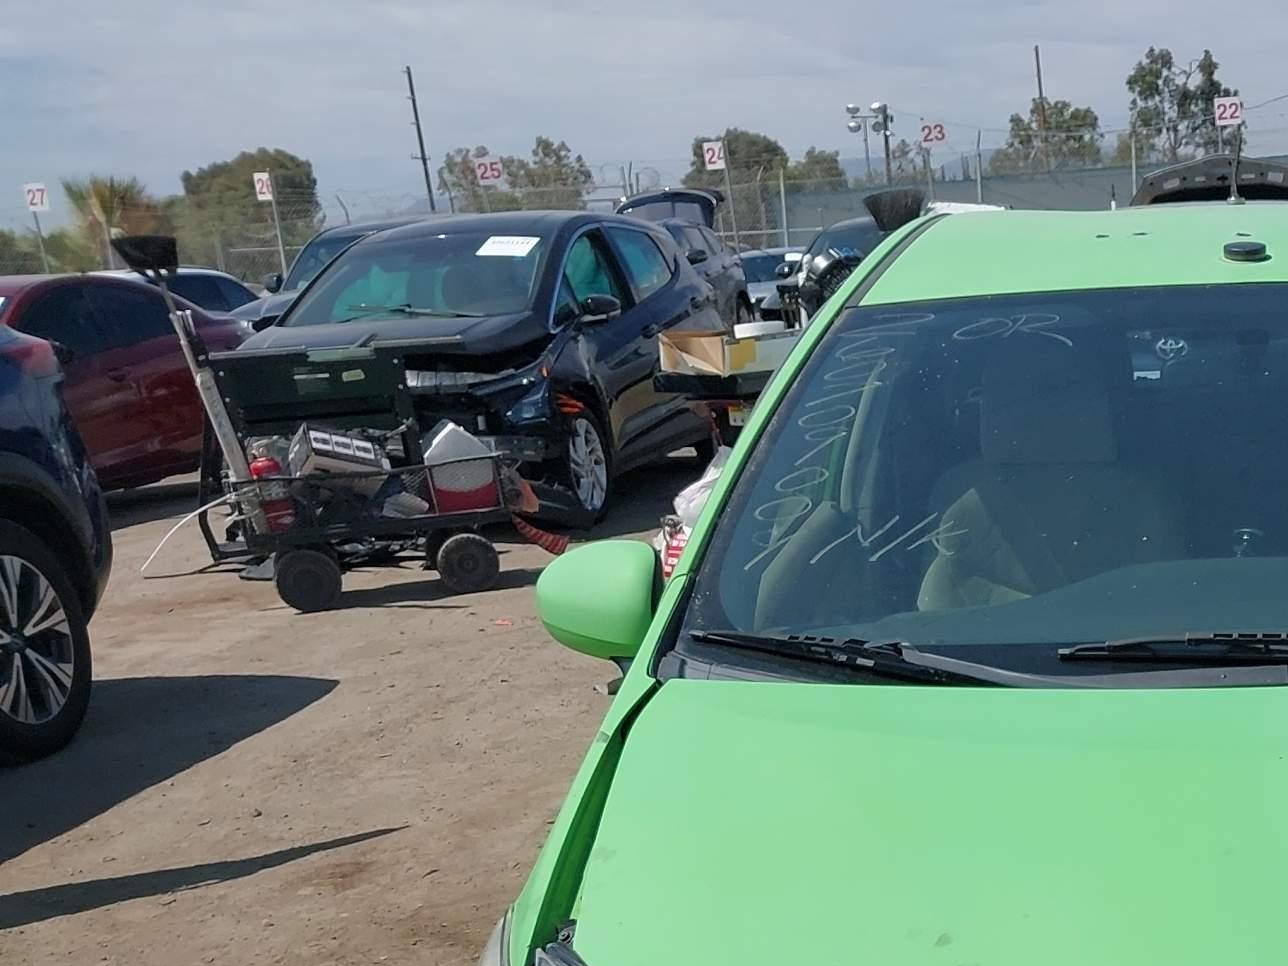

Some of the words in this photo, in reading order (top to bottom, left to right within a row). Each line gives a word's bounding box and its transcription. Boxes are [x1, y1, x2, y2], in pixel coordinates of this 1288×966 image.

[1216, 102, 1240, 120] 22
[922, 124, 946, 143] 23
[477, 162, 502, 180] 25
[26, 188, 46, 206] 27
[953, 313, 1074, 347] OR
